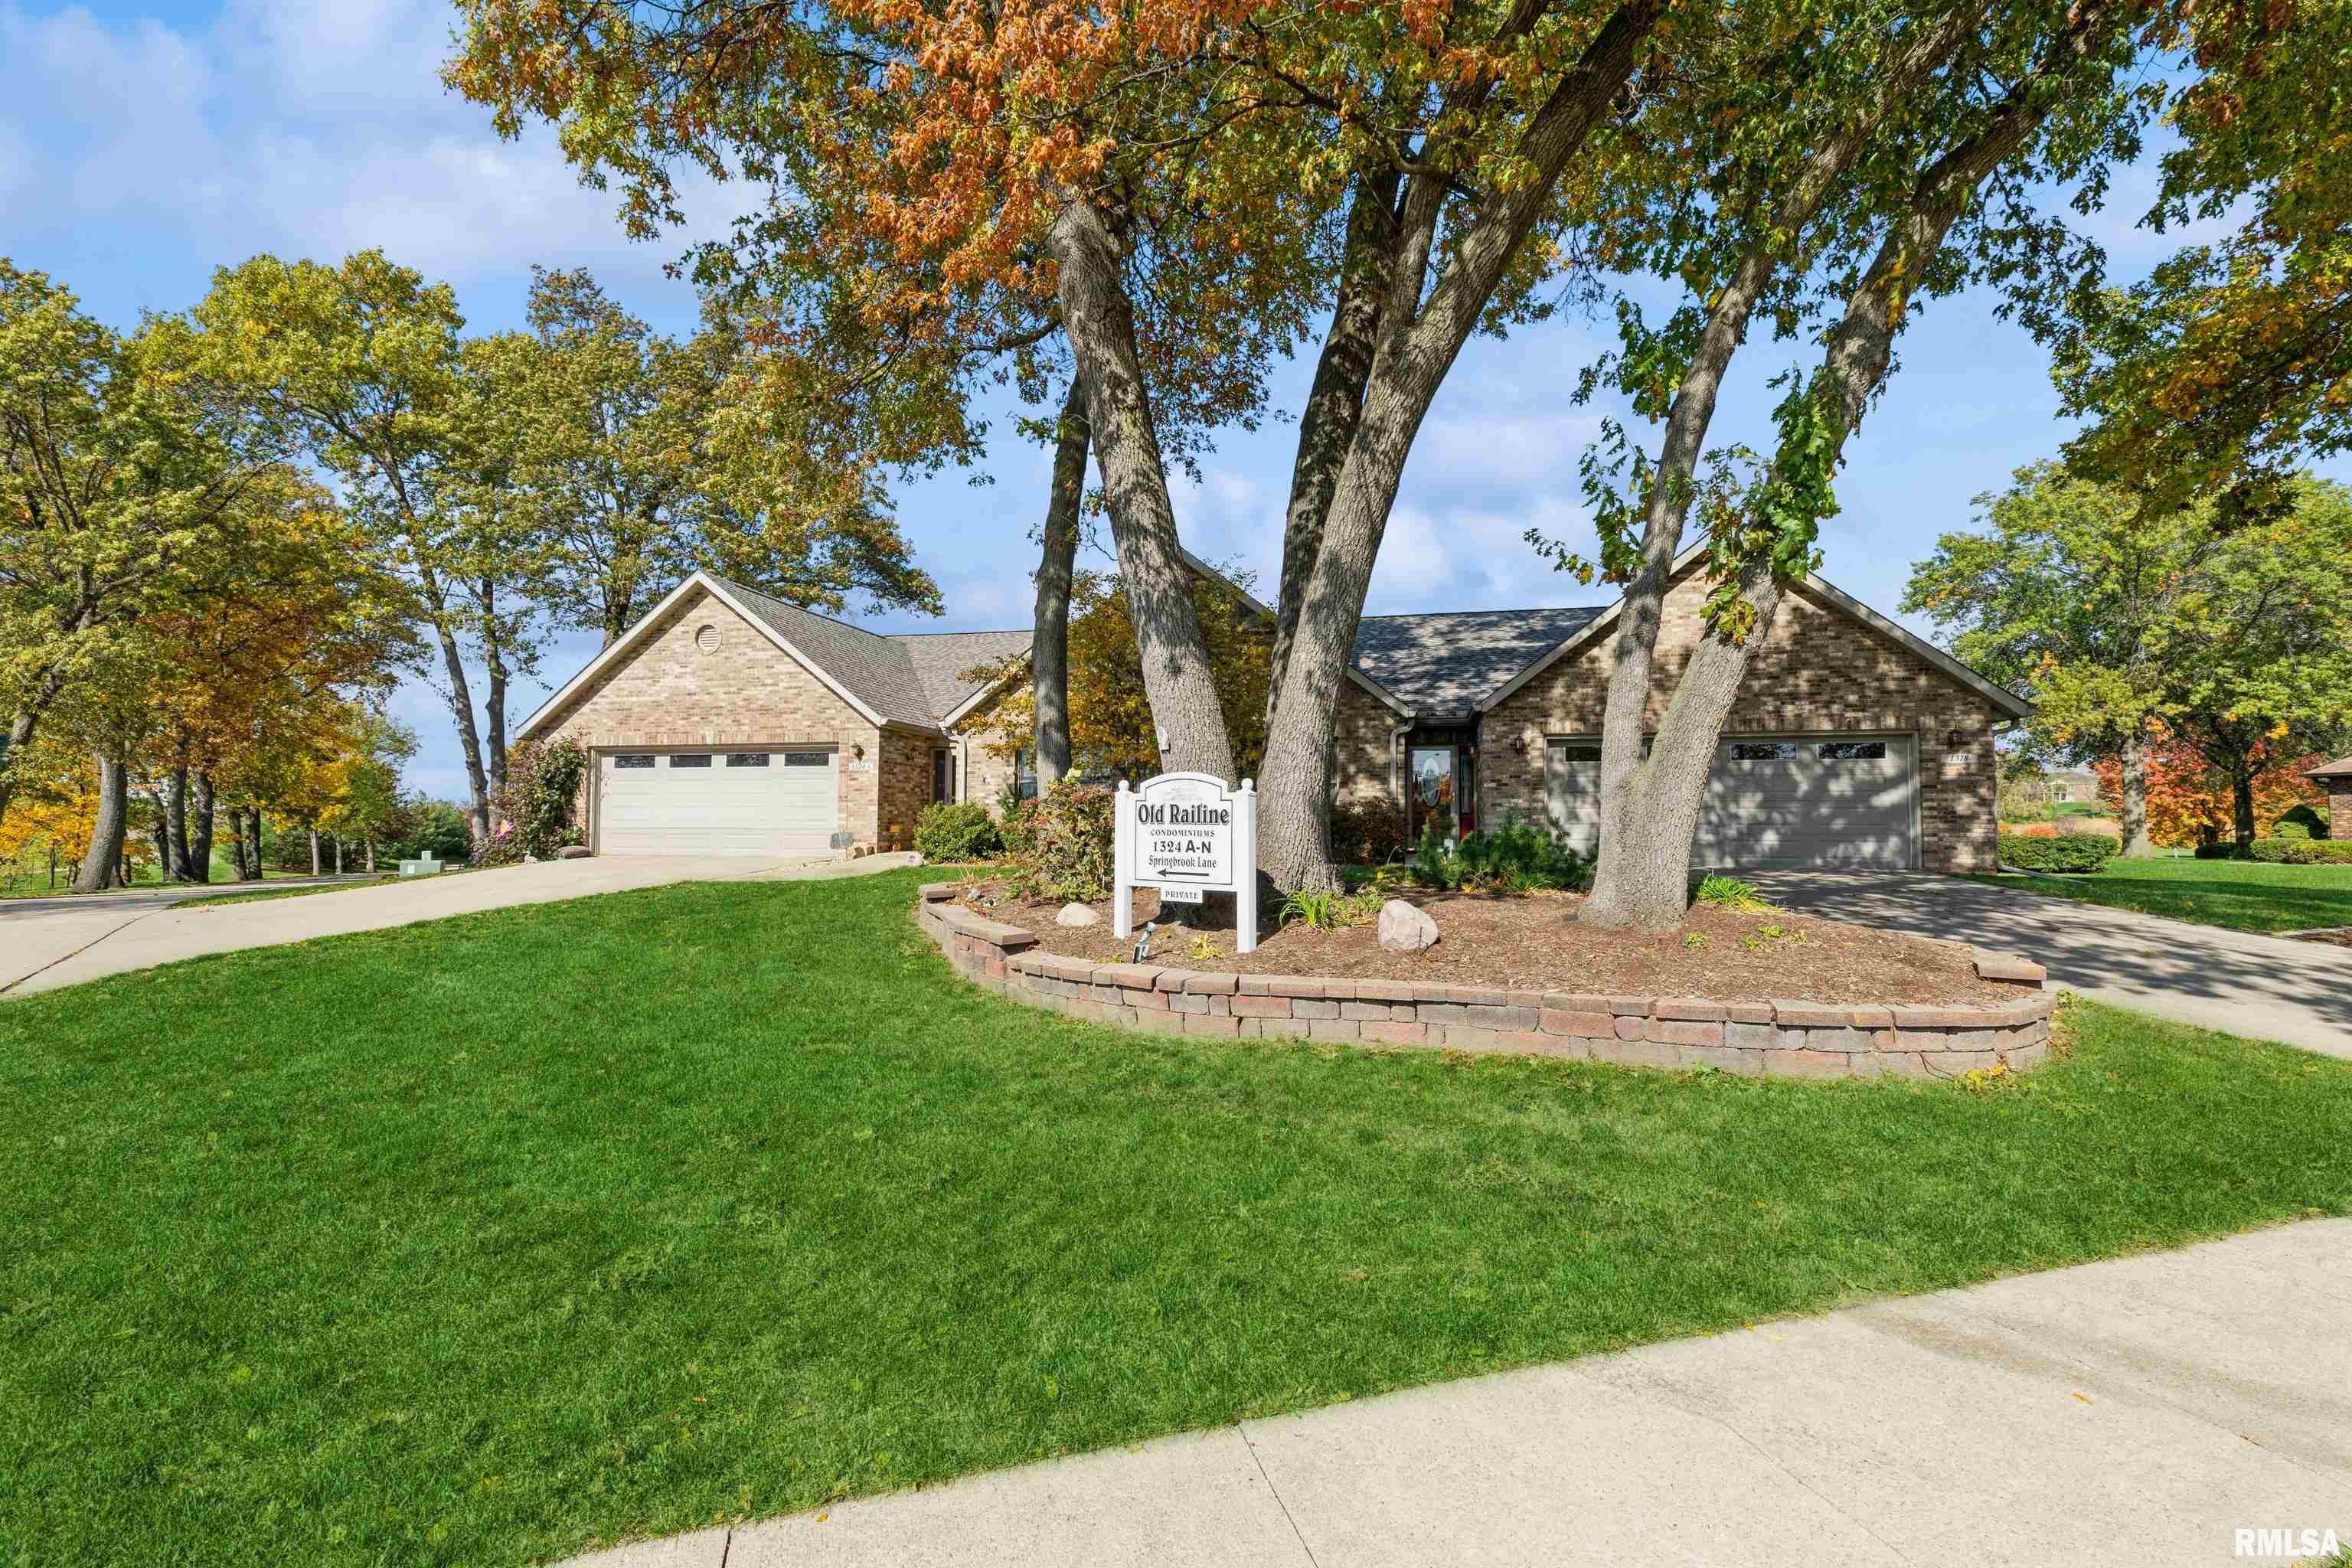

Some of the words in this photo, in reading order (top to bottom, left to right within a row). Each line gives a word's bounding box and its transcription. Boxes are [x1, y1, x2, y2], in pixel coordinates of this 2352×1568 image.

[1138, 803, 1165, 825] Old
[1169, 803, 1230, 825] Railine
[1151, 828, 1215, 838] CONDOMINIUMS
[1154, 841, 1181, 852] 1324
[1185, 840, 1211, 854] A-N
[1148, 854, 1195, 868] Springbrook
[1197, 857, 1217, 868] Lane
[1165, 890, 1197, 900] PRIVATE
